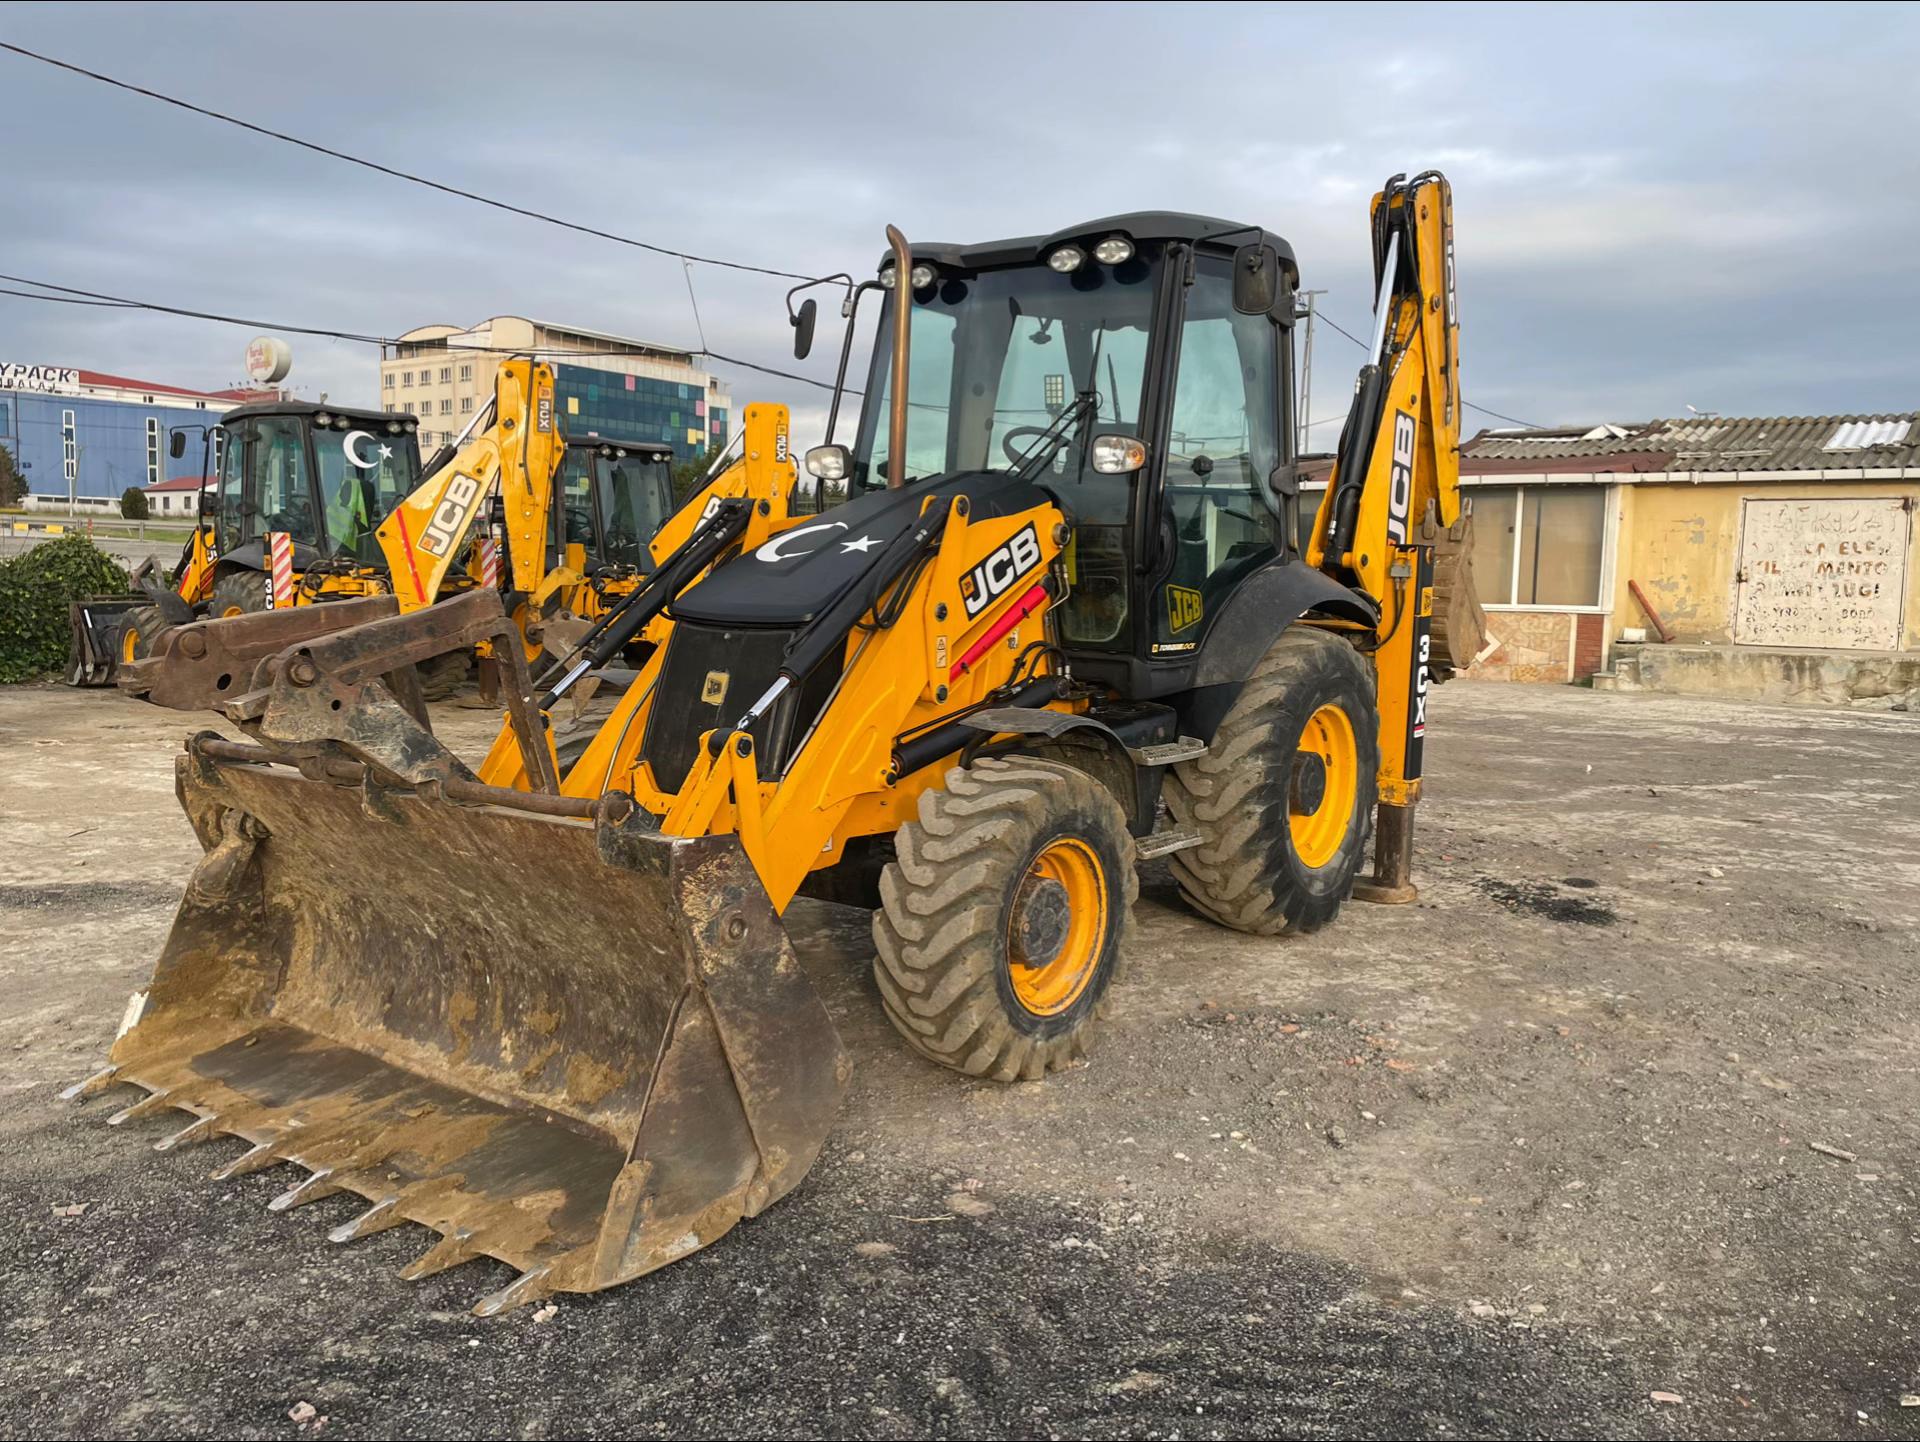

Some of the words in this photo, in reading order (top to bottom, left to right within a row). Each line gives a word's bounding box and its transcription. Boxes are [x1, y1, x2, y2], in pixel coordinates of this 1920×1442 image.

[539, 401, 550, 428] 3CX
[776, 435, 787, 461] 3CX
[427, 474, 478, 555] JCB
[1389, 414, 1414, 545] JCB
[965, 527, 1040, 614] JCB
[1171, 589, 1201, 629] JCB
[1414, 634, 1430, 725] 3CX
